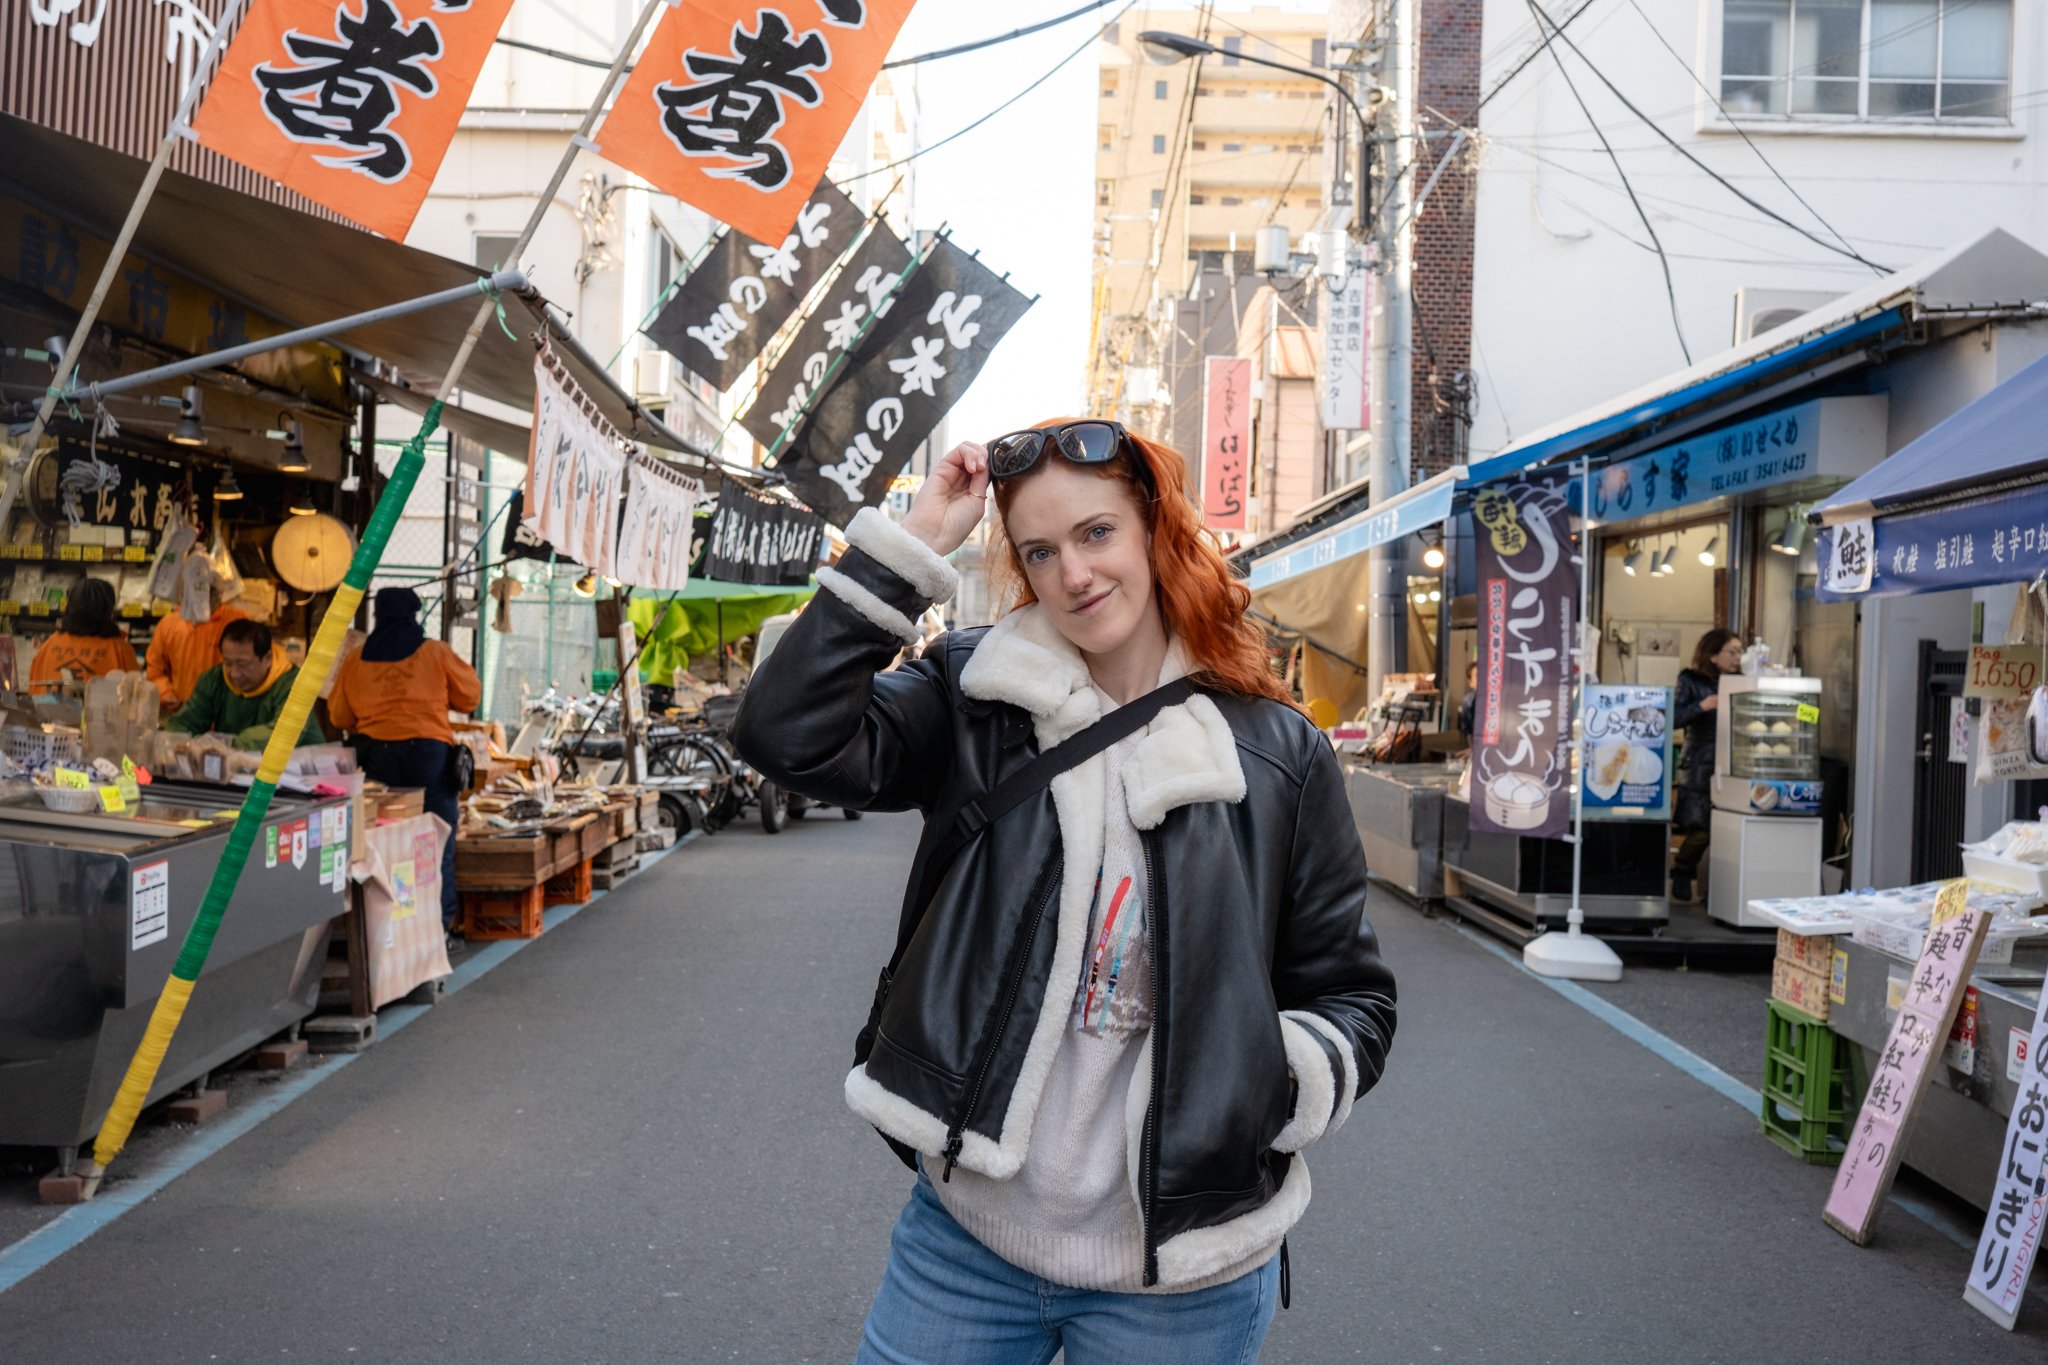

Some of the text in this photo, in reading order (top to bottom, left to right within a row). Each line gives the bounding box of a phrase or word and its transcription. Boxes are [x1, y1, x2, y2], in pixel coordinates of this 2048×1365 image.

[1838, 525, 1867, 580] 鮭
[1973, 646, 2002, 662] Bag
[1973, 660, 2035, 690] 1,650
[1994, 764, 2027, 776] TOKYO
